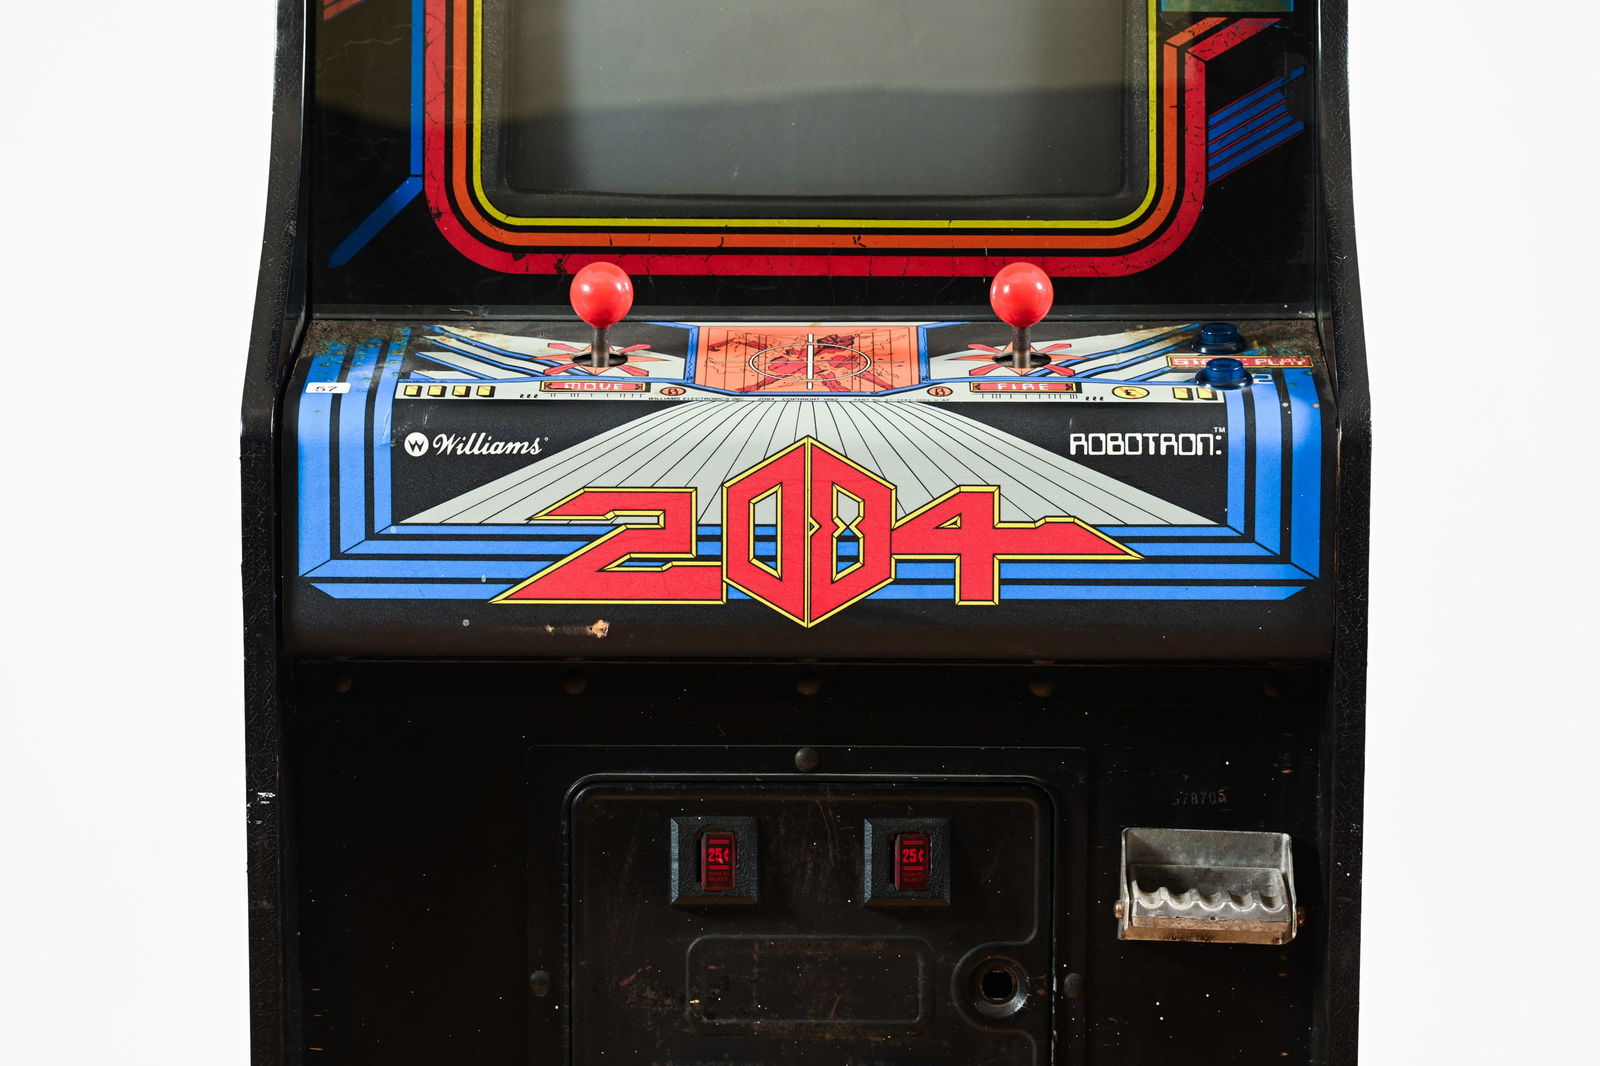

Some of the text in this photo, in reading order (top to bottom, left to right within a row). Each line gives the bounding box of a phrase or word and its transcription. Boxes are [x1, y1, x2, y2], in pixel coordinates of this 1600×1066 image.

[1254, 358, 1306, 366] PLAY
[432, 432, 542, 456] Williams
[489, 435, 1145, 629] 2084
[708, 847, 730, 863] 25¢
[902, 848, 925, 863] 25¢
